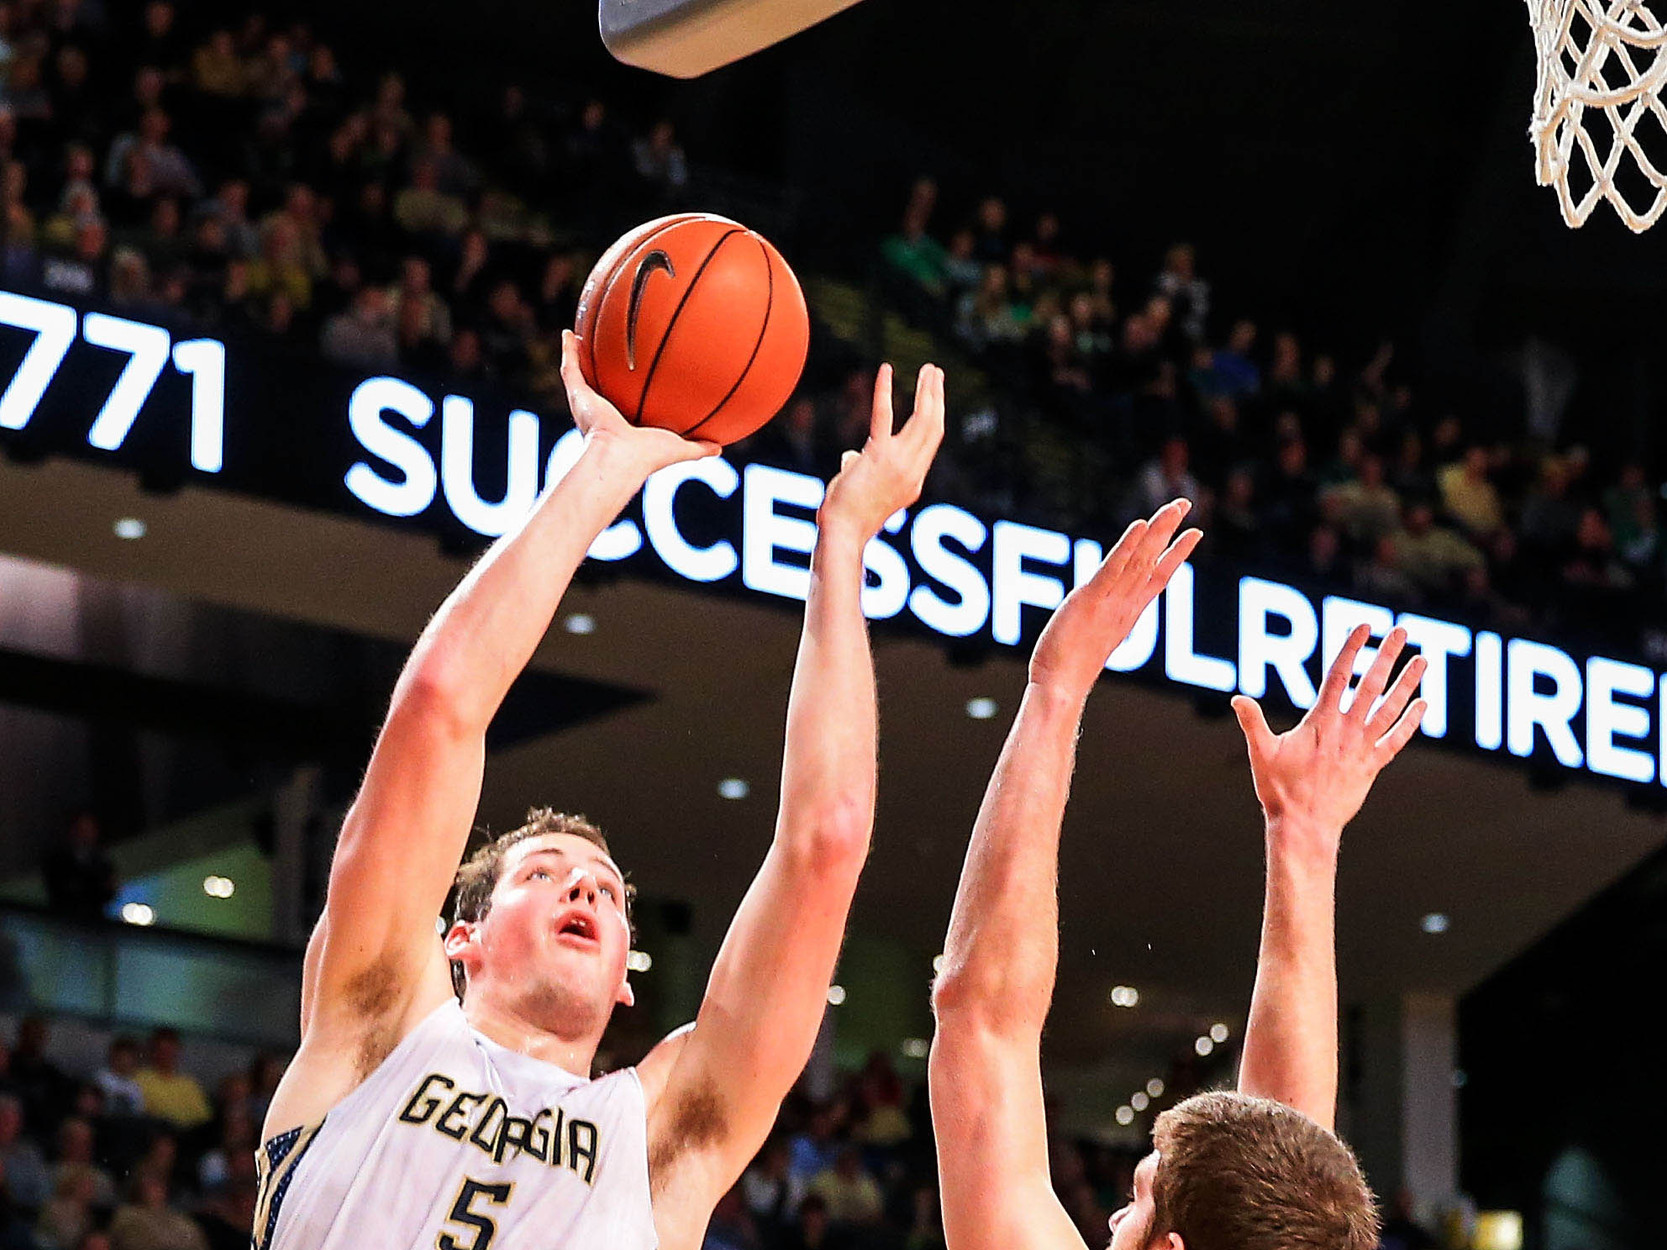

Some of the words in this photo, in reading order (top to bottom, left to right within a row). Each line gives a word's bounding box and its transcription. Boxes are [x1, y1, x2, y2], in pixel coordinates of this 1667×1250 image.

[0, 292, 225, 472] 771
[346, 378, 1667, 786] SUCESSFULRETIRE
[398, 1073, 598, 1185] GEORGIA
